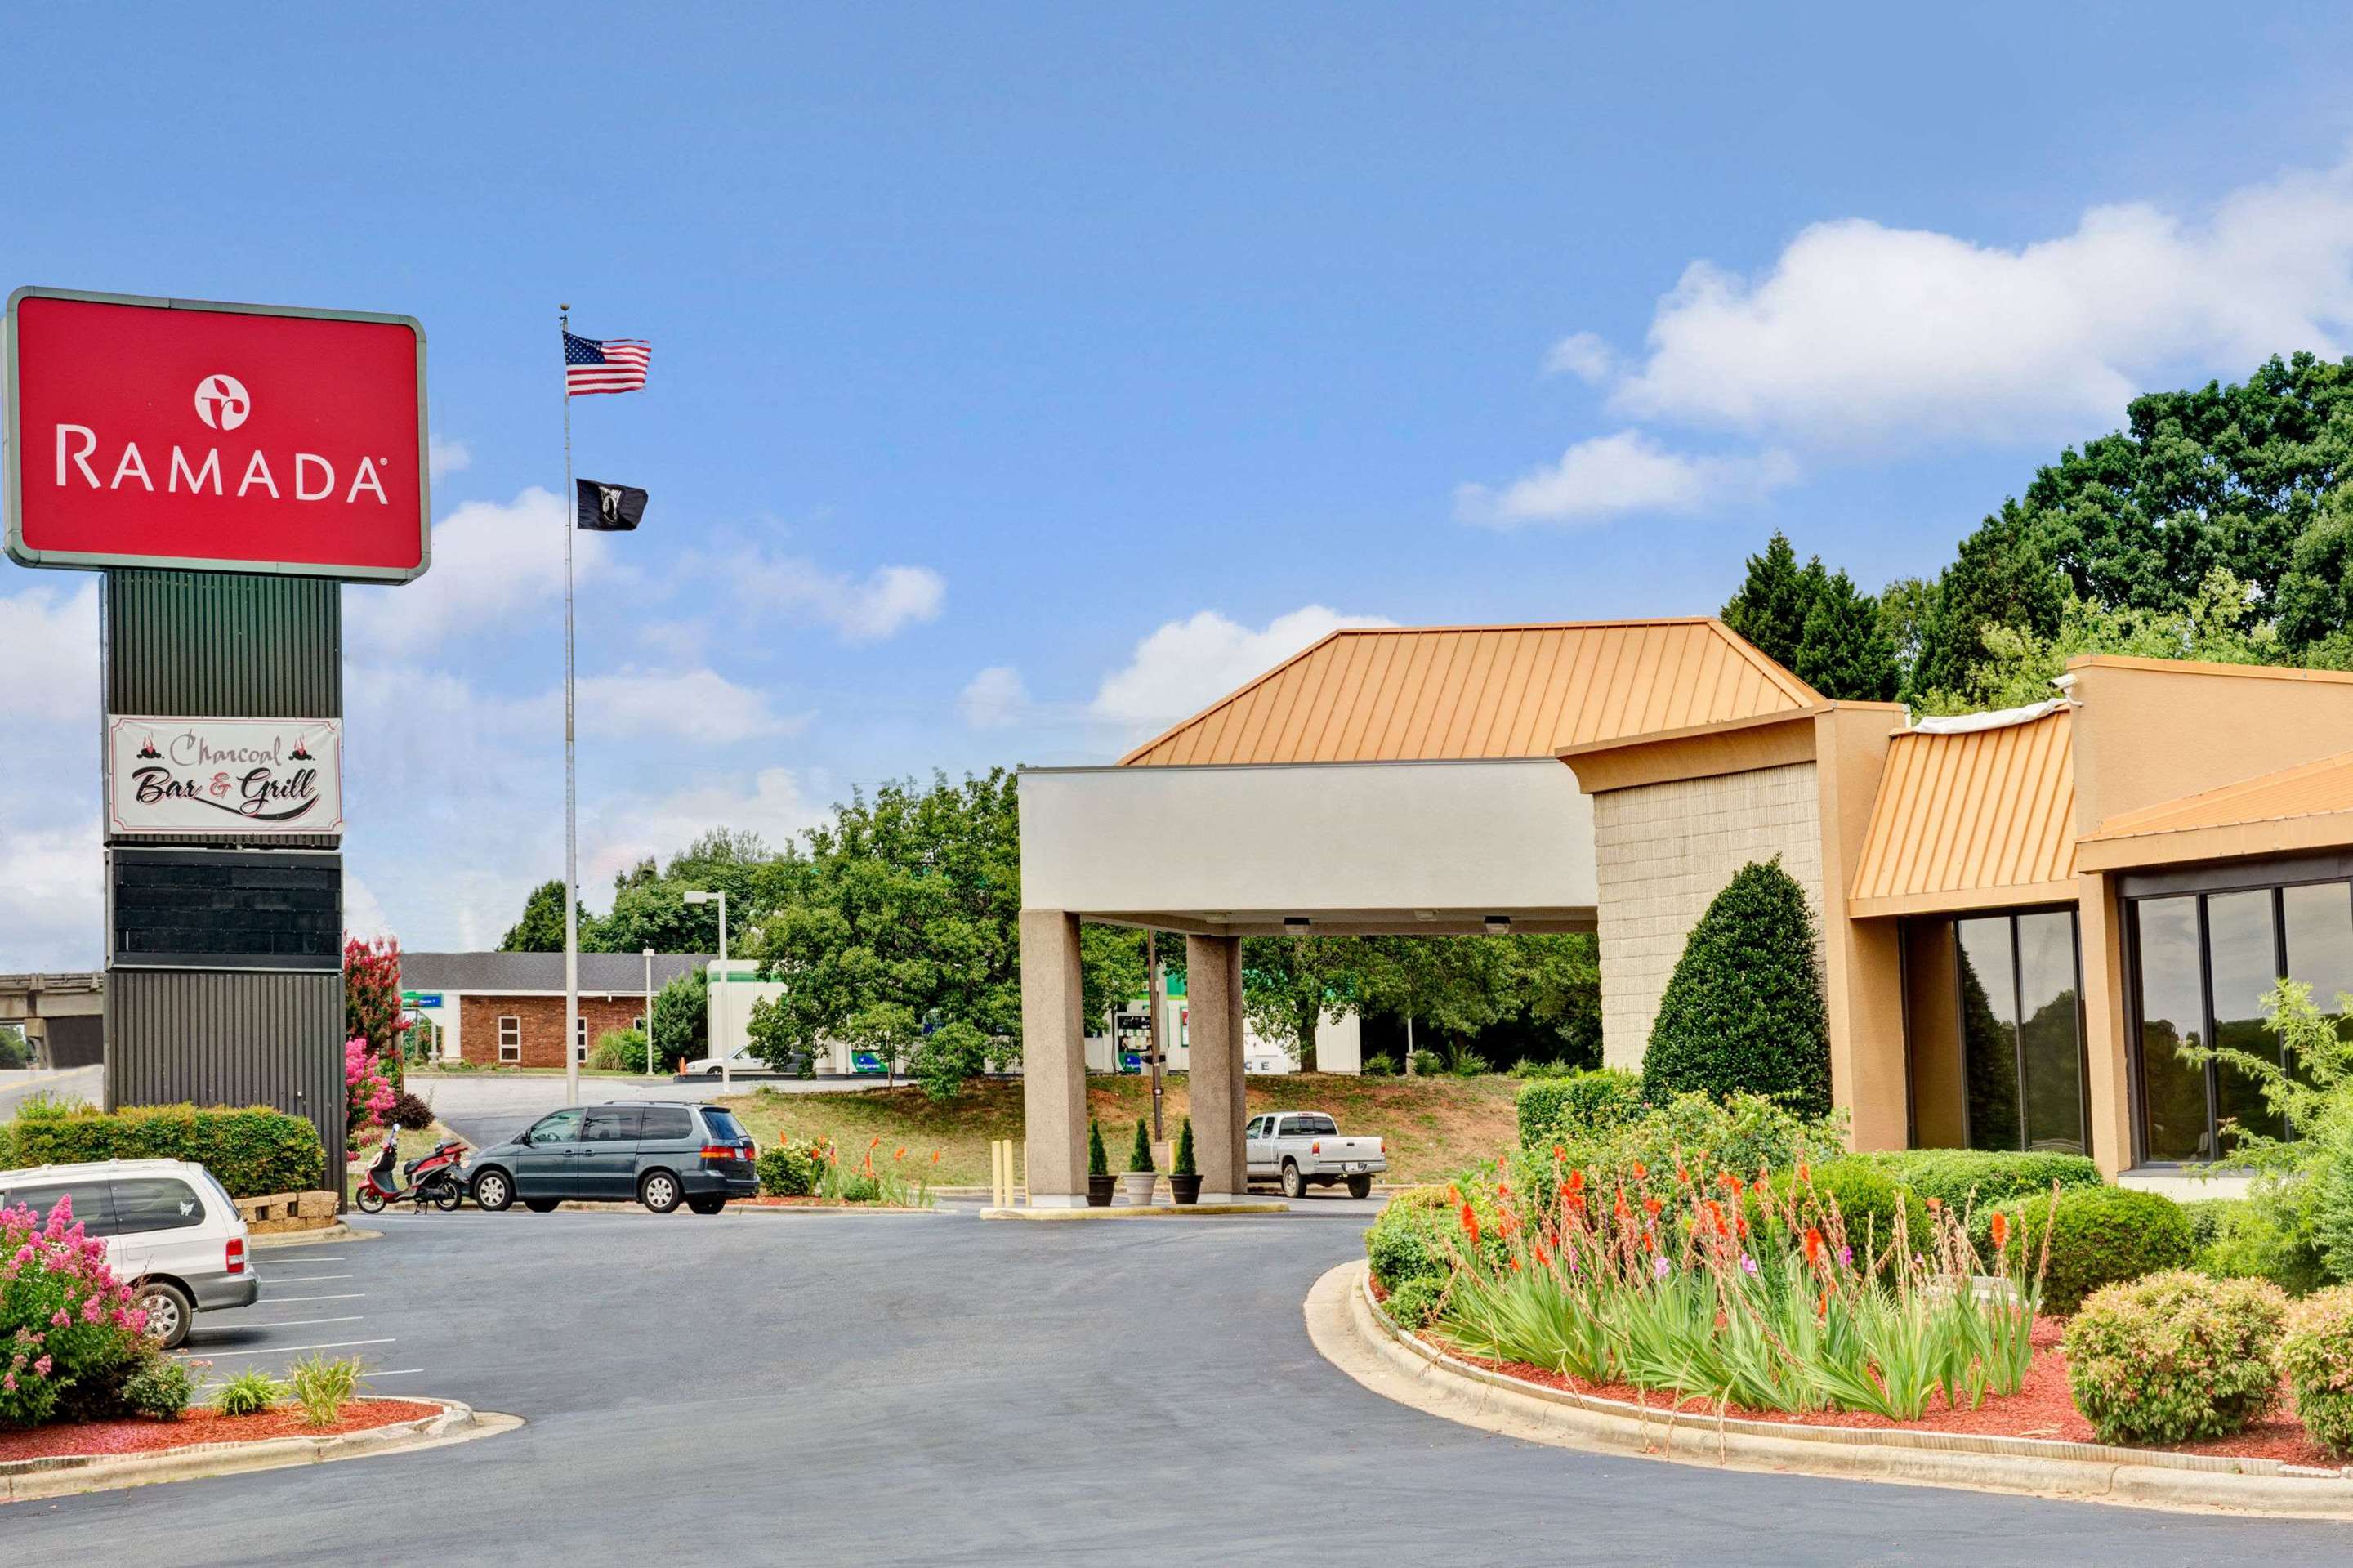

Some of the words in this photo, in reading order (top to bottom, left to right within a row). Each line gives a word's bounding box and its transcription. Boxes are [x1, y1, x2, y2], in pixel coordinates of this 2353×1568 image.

[56, 424, 388, 505] RAMADA
[169, 729, 282, 766] Charcoal
[132, 766, 201, 804] Bar
[209, 771, 232, 797] &
[236, 766, 319, 814] Grill
